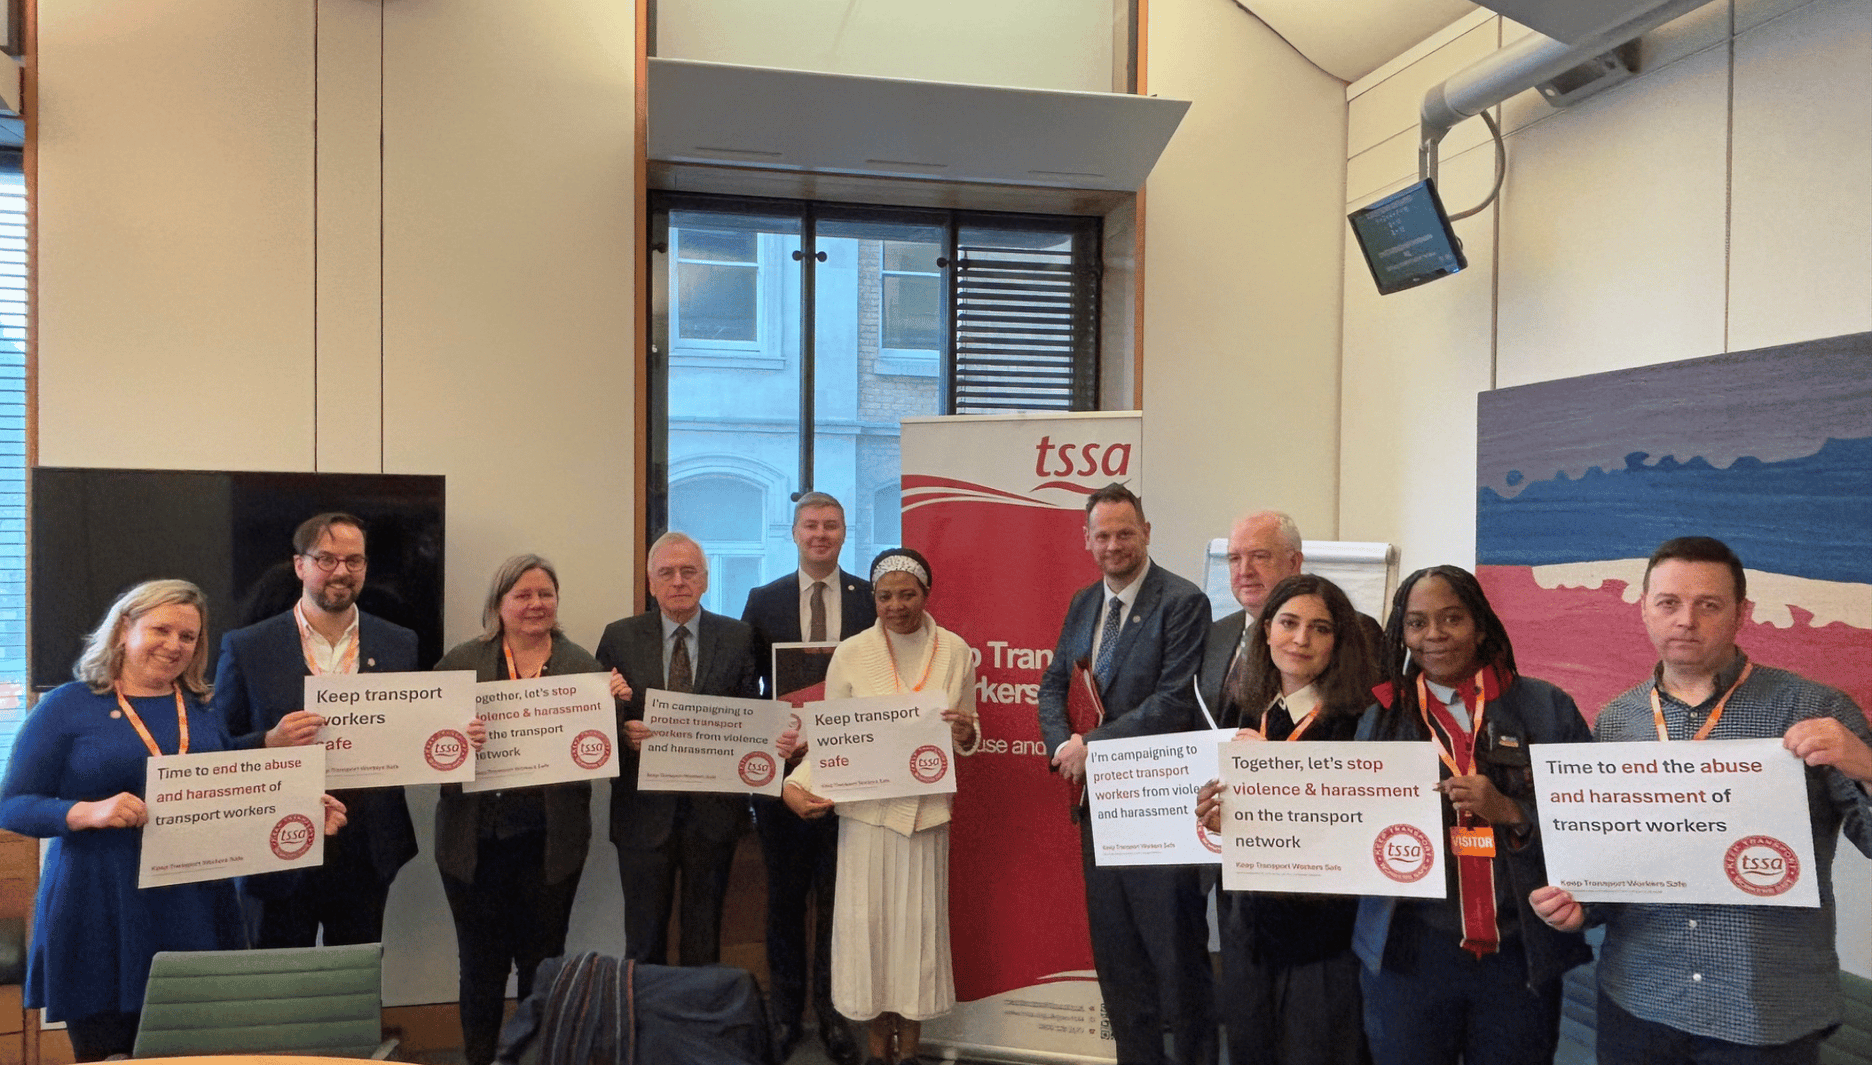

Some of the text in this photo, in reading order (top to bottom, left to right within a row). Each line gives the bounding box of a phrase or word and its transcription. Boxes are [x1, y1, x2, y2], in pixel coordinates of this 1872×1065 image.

[1035, 435, 1132, 477] tssa
[986, 641, 1054, 669] Tran
[317, 687, 443, 705] Keep transport
[475, 691, 522, 704] ogether,
[552, 686, 577, 697] stop
[974, 675, 1041, 705] rkers
[475, 702, 601, 721] iolence & harassment
[652, 698, 754, 716] I'm campaigning to
[650, 715, 742, 729] protect transport
[815, 706, 920, 726] Keep transport
[488, 730, 507, 740] the
[510, 724, 563, 737] transport
[695, 731, 721, 741] from
[723, 734, 768, 744] violence
[817, 733, 874, 747] workers
[435, 743, 459, 754] tssa
[648, 743, 668, 752] and
[671, 744, 734, 756] harassment
[1091, 745, 1198, 763] I'm campaigning to
[158, 759, 302, 780] Time to end the abuse
[820, 755, 849, 768] safe
[1232, 756, 1304, 772] Together,
[1347, 758, 1383, 773] stop
[1546, 758, 1763, 774] Time to end the abuse
[1093, 765, 1189, 784] protect transport
[156, 781, 282, 803] and harassment of
[1095, 784, 1200, 800] workers from viole
[1233, 783, 1420, 797] violence & harassment
[1550, 788, 1732, 803] and harassment of
[155, 805, 276, 826] transport workers
[1098, 804, 1189, 819] and harassment
[1234, 809, 1363, 825] on the transport
[1553, 818, 1727, 835] transport workers
[1235, 835, 1301, 848] network
[1388, 842, 1421, 857] tssa
[1452, 836, 1494, 849] VISITOR
[1742, 855, 1783, 870] tssa
